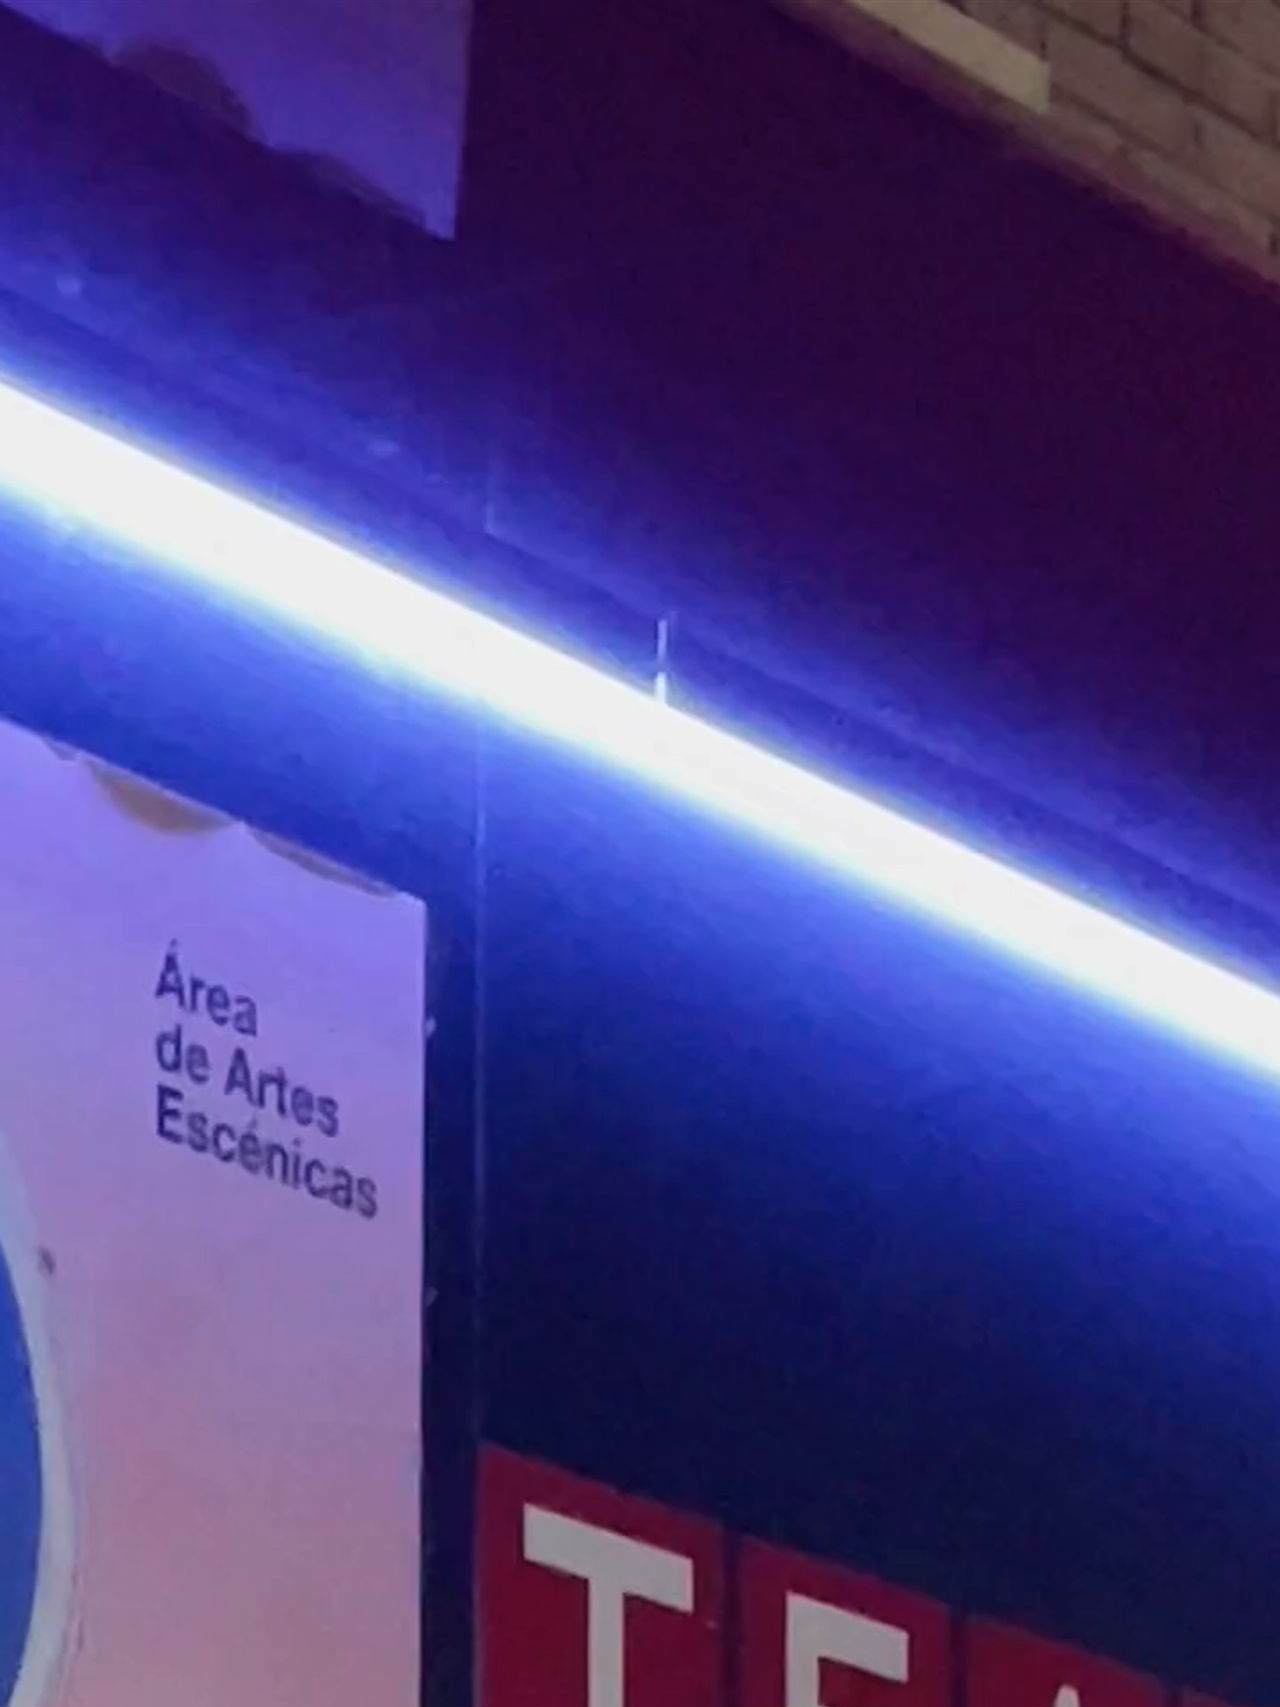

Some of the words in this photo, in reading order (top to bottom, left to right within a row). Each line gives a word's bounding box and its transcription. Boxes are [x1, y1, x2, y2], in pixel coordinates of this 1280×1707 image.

[155, 938, 257, 1037] Área
[156, 1023, 209, 1084] de
[225, 1047, 339, 1138] Artes
[156, 1083, 377, 1221] Escénicas
